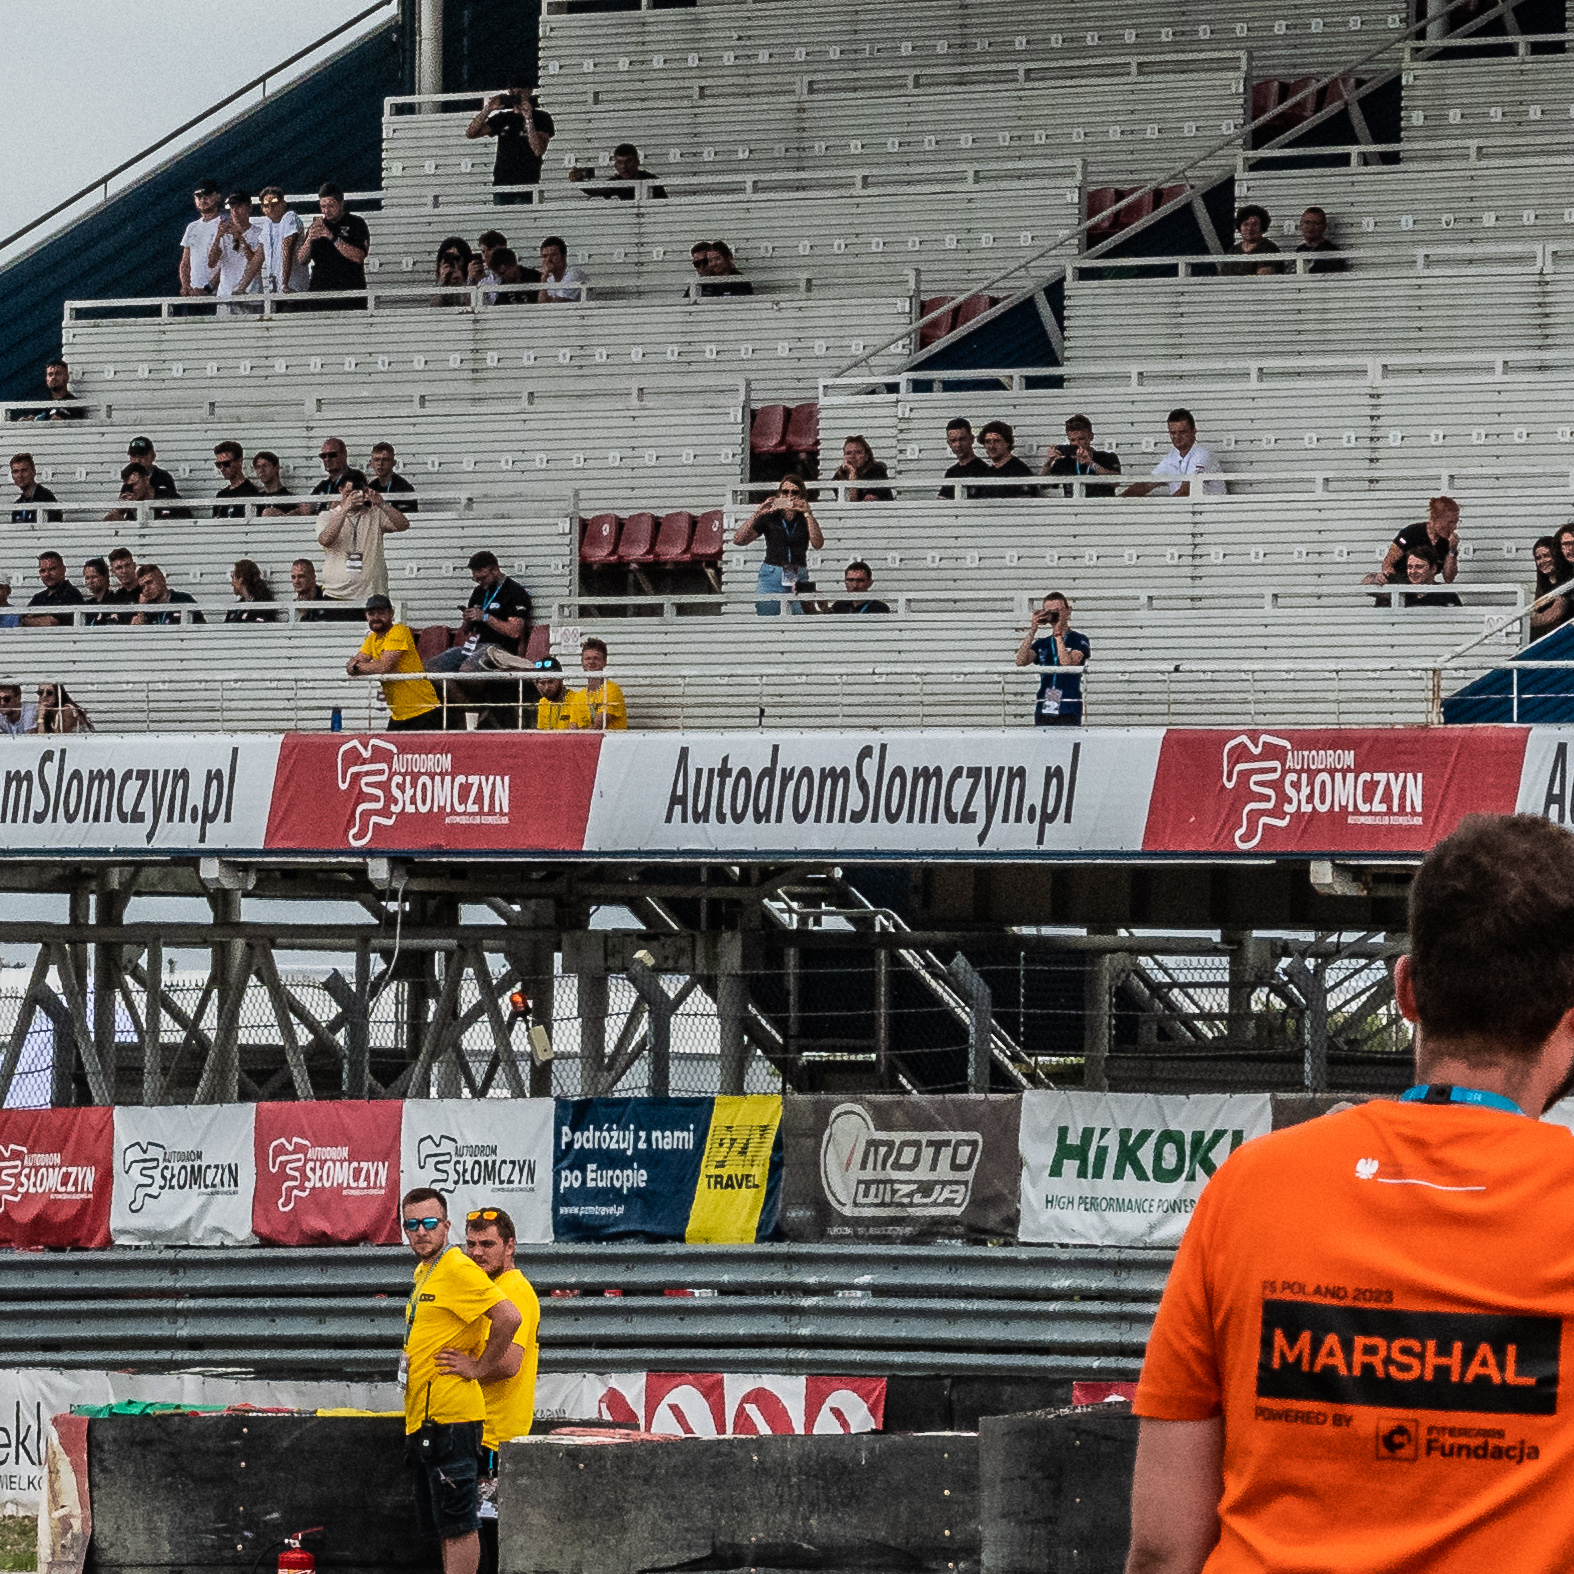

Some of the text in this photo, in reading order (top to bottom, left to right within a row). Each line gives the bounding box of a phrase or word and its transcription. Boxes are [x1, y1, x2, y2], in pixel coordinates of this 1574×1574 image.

[392, 753, 452, 773] AUTODROM
[1285, 750, 1355, 769] AUTODROM
[390, 775, 510, 813] SŁOMCZYN
[665, 742, 1082, 847] AutodromSlomczyn.pl
[1283, 772, 1423, 813] SŁOMCZYN
[561, 1123, 634, 1156] Podróżuj
[638, 1130, 647, 1150] z
[652, 1124, 694, 1150] nami
[859, 1138, 977, 1173] MOTO
[20, 1165, 95, 1194] SŁOMCZYN
[159, 1163, 239, 1191] SŁOMCZYN
[305, 1160, 389, 1188] SŁOMCZYN
[452, 1159, 536, 1187] SŁOMCZYN
[560, 1162, 648, 1194] po Europie
[705, 1173, 760, 1190] TRAVEL
[856, 1180, 967, 1206] WIZJA
[1045, 1194, 1074, 1210] HIGH
[1078, 1196, 1155, 1213] PERFORMANCE
[1281, 1281, 1348, 1300] POLAND
[1272, 1328, 1537, 1386] MARSHAL
[1255, 1406, 1352, 1428] POWERED BY
[1425, 1439, 1540, 1465] Fundacja
